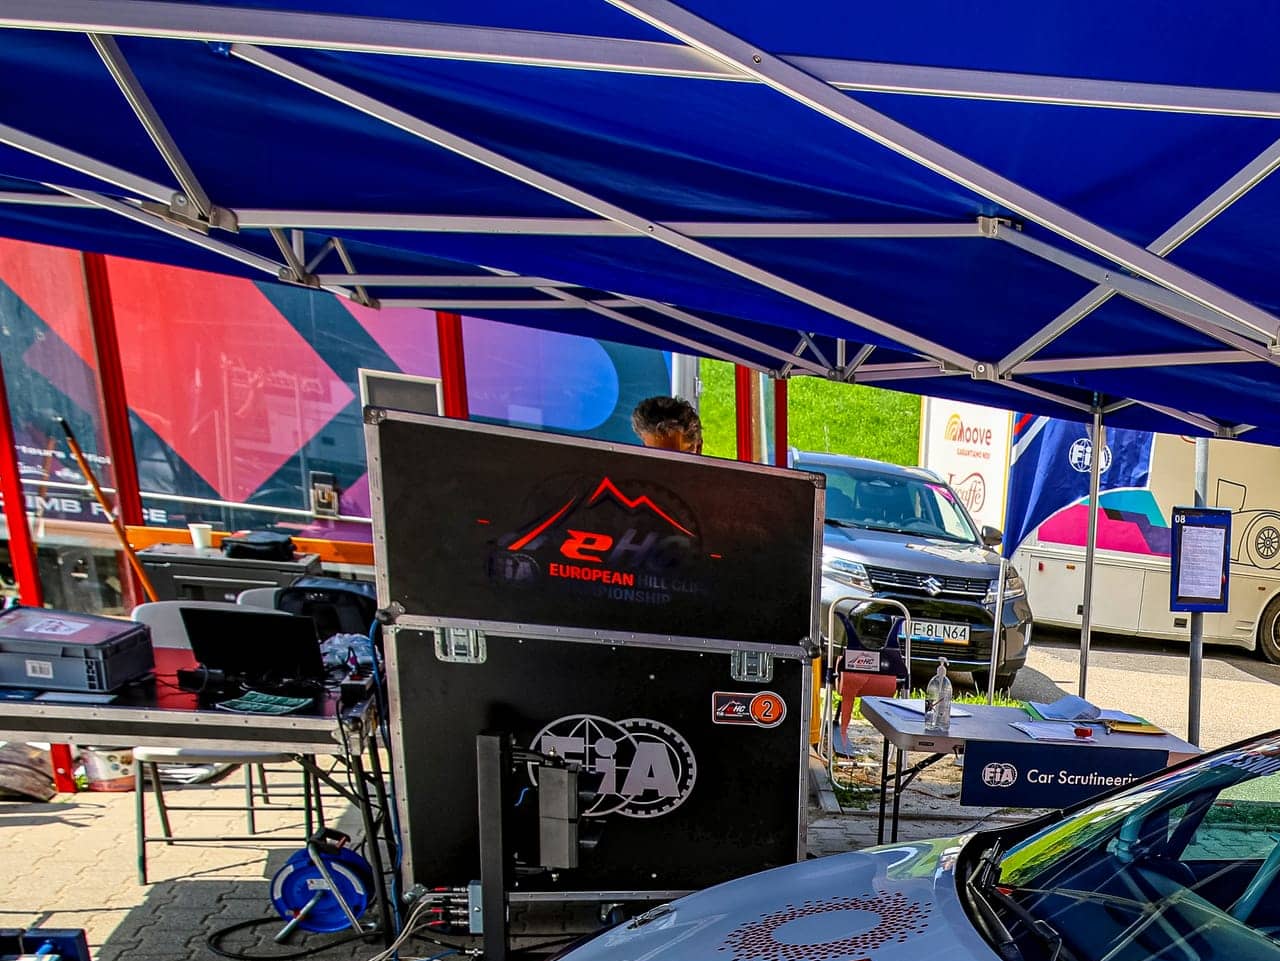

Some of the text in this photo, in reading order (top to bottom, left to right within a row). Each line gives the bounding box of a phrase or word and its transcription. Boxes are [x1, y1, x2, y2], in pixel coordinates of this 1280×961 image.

[549, 562, 636, 588] EUROPEAN
[926, 624, 968, 641] 8LN64
[762, 700, 774, 719] 2
[1026, 768, 1053, 785] Car
[1057, 770, 1139, 788] Scrutineerin
